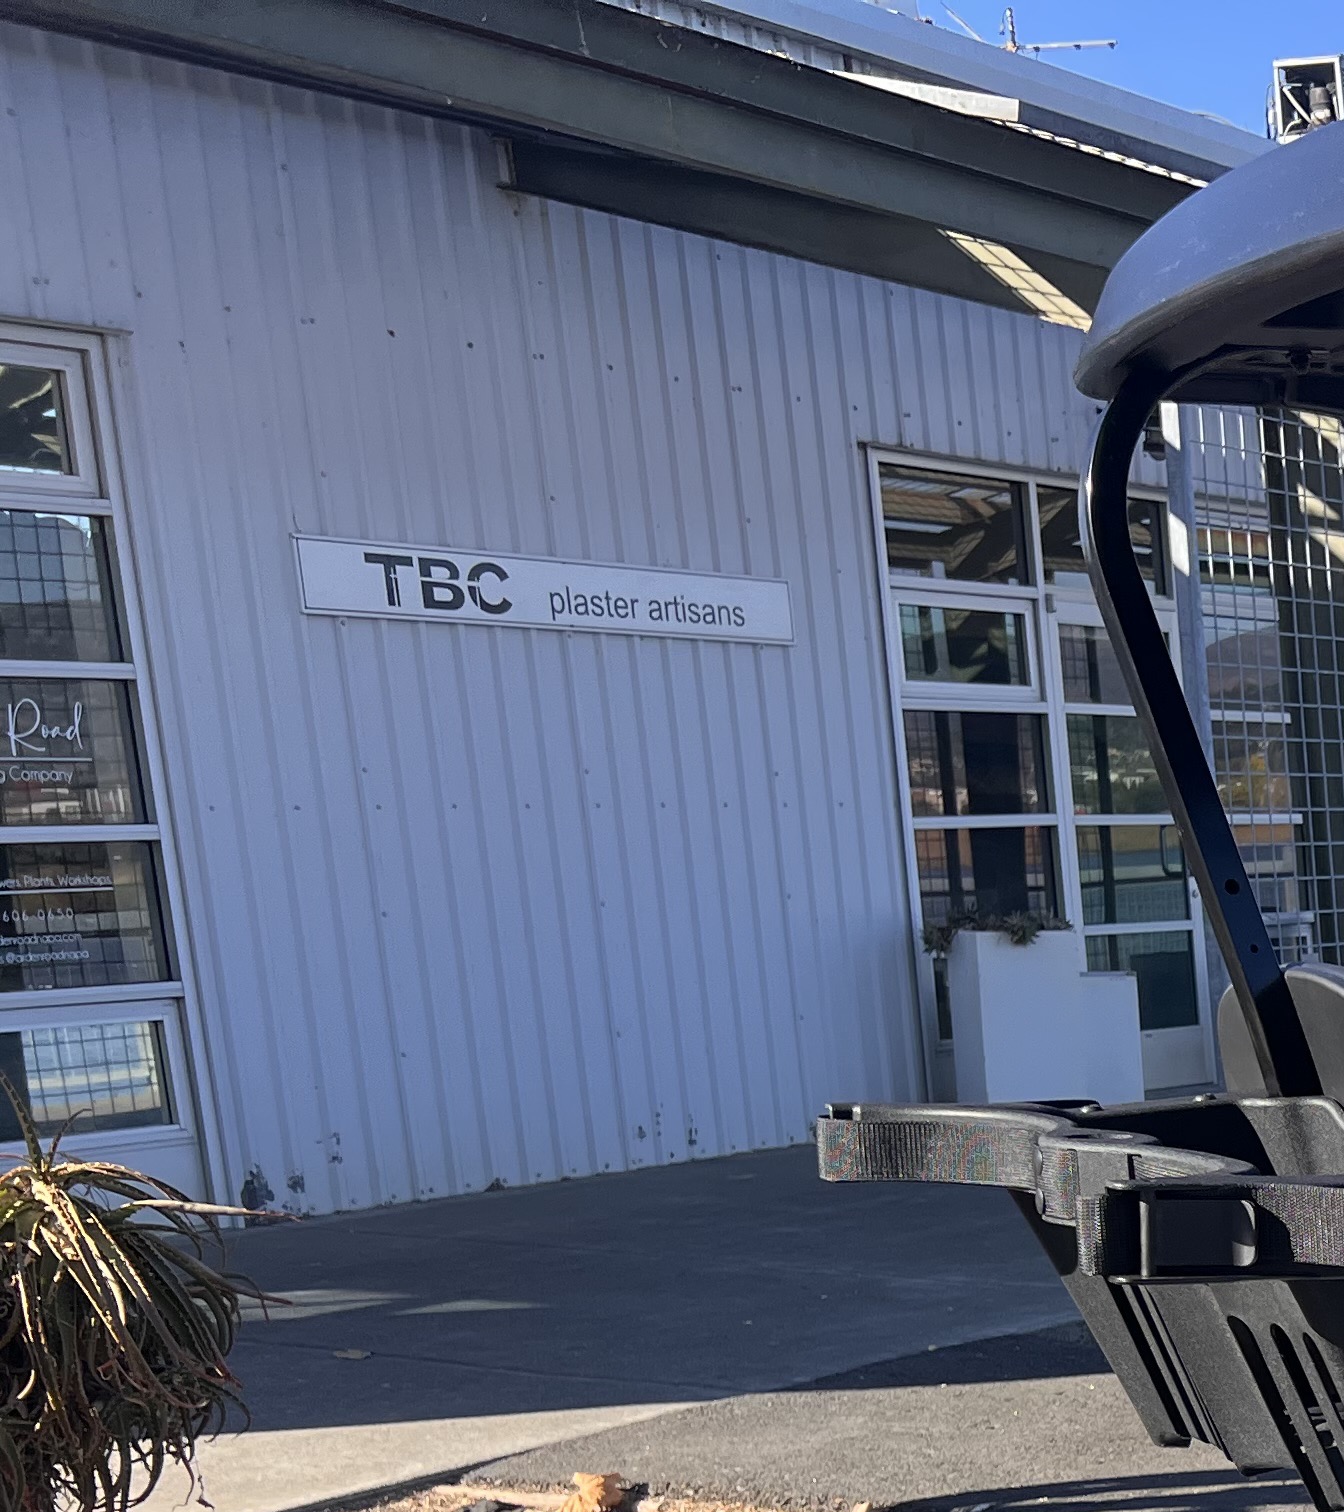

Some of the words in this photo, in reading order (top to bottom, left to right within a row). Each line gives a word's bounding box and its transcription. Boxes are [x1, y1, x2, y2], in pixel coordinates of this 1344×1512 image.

[363, 551, 513, 615] TBC
[549, 586, 638, 622] plaster
[648, 595, 746, 628] artisans
[7, 698, 83, 756] Road
[8, 765, 73, 785] Company
